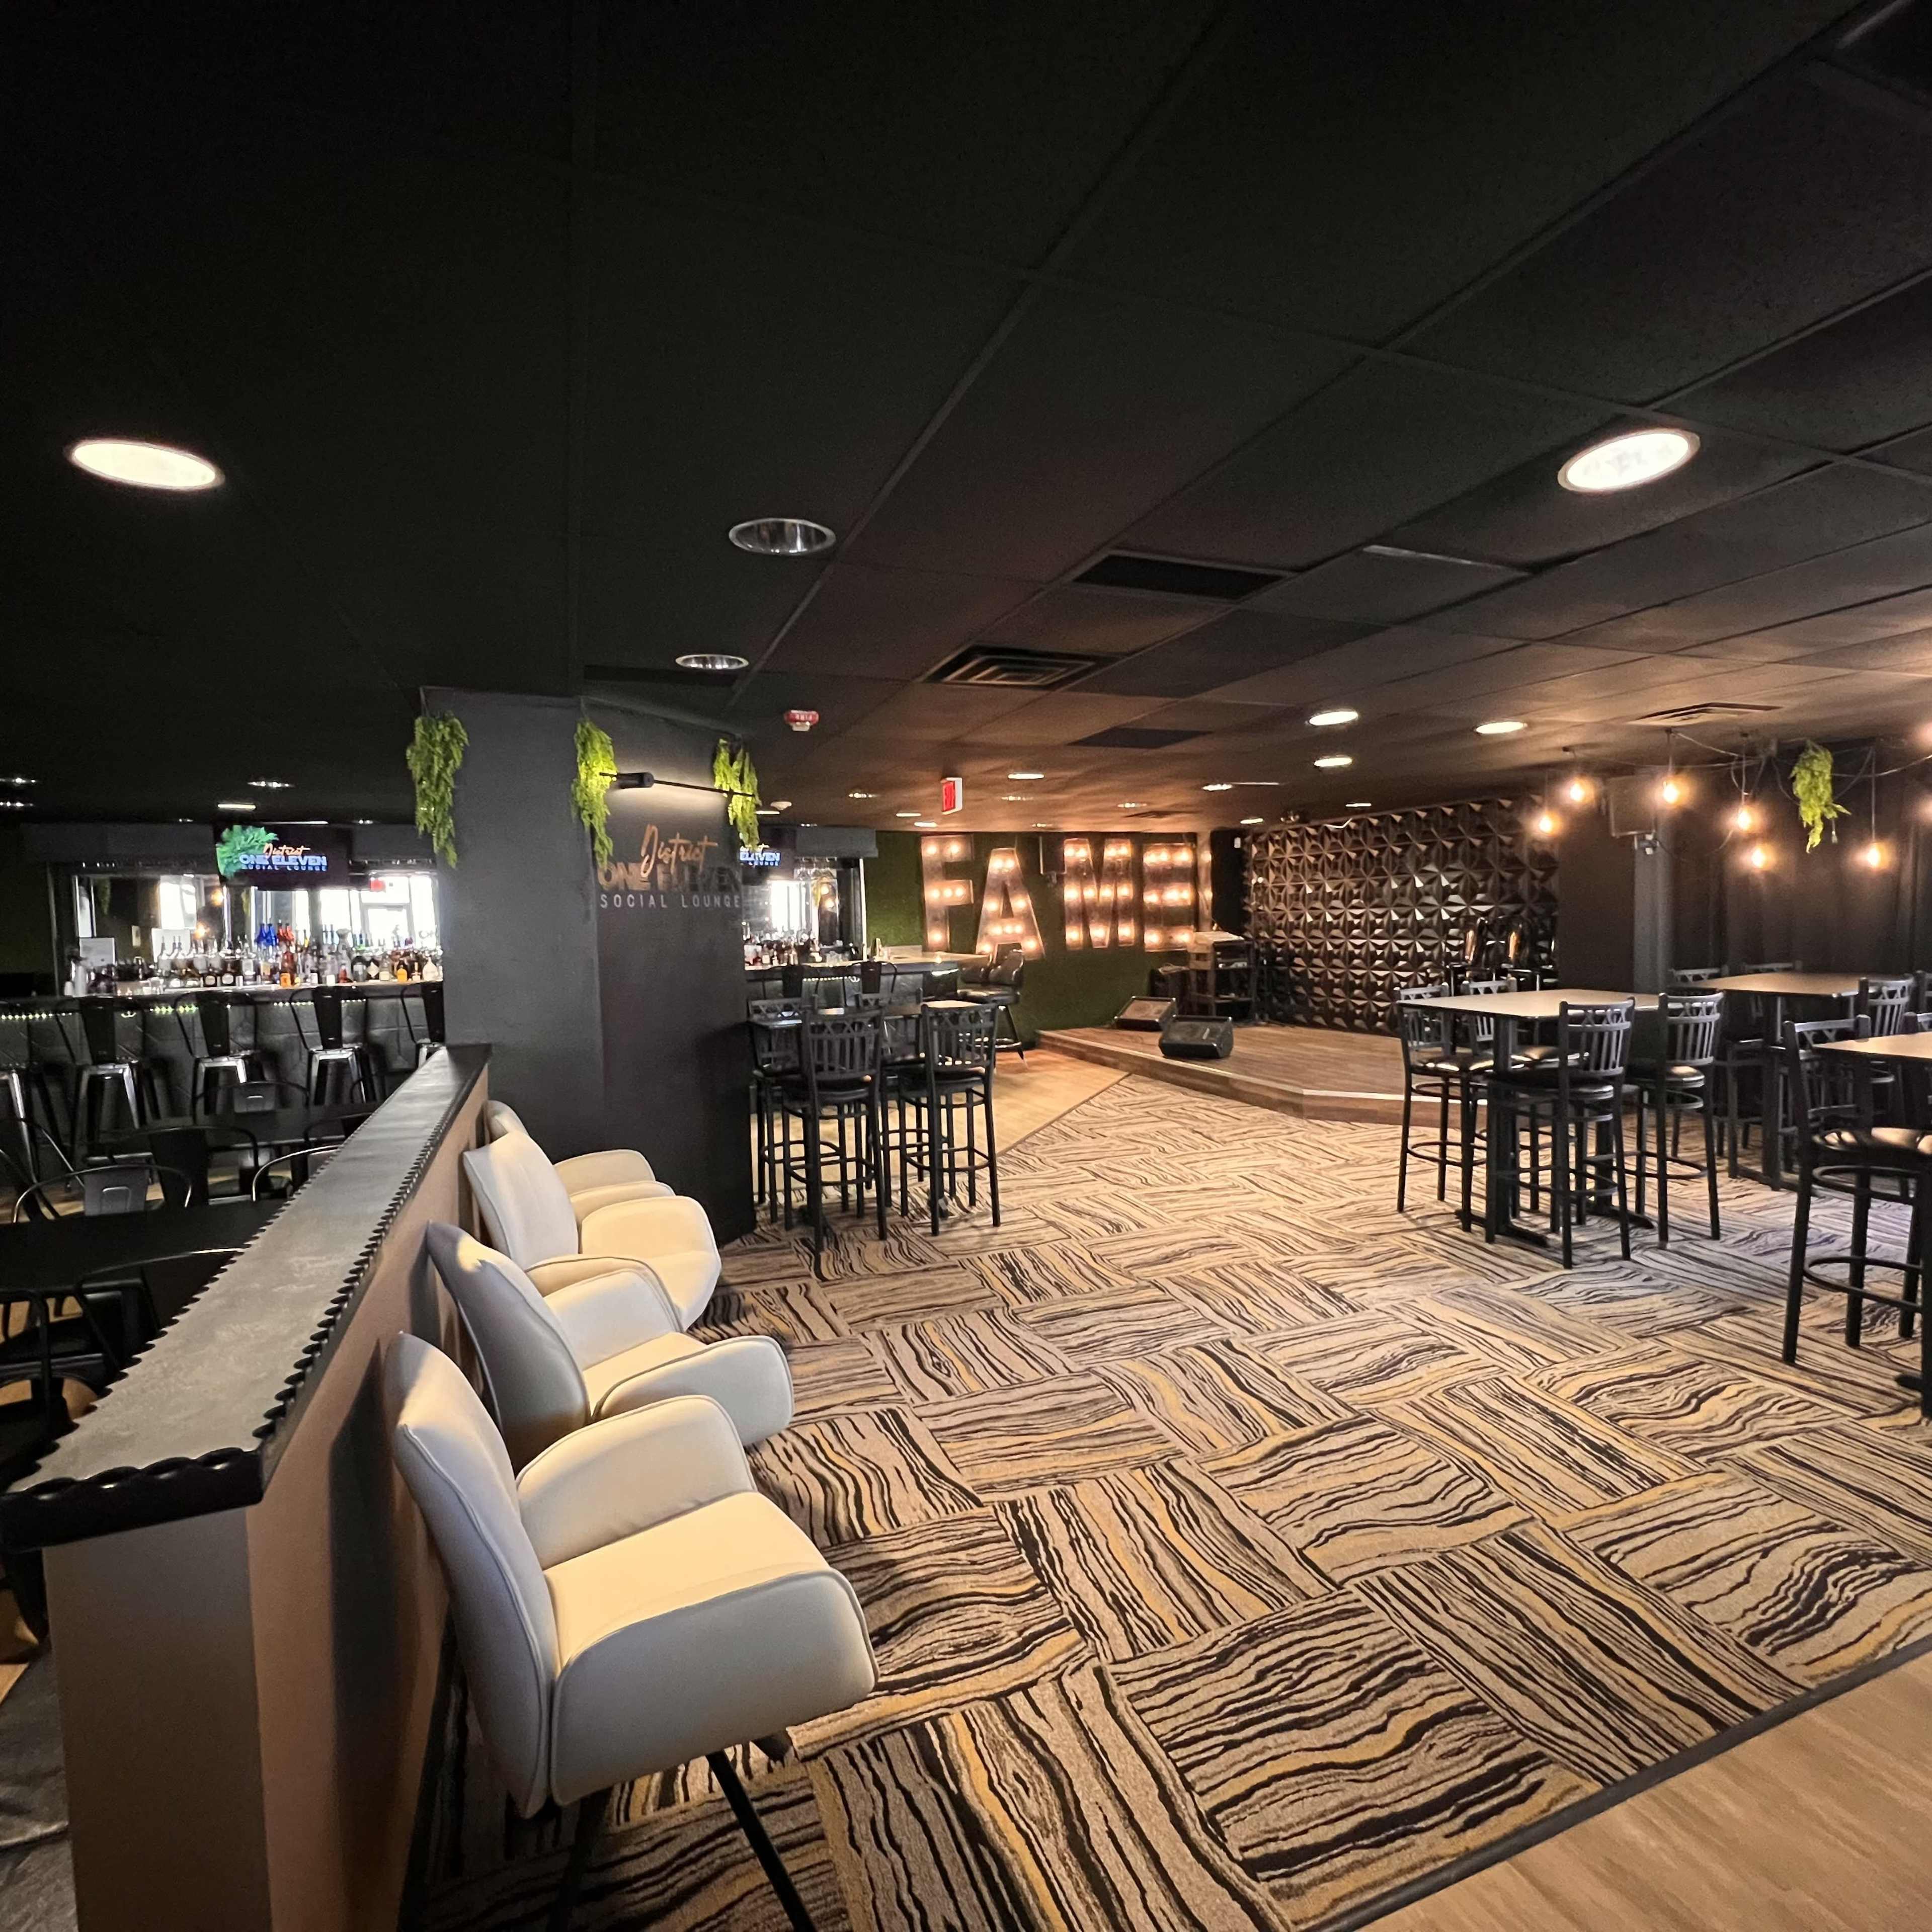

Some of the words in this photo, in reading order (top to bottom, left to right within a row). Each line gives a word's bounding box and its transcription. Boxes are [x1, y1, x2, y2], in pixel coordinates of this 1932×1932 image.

[239, 854, 269, 865] ONE
[272, 855, 327, 865] ELEVEN
[641, 824, 718, 876] District
[598, 861, 651, 890] ONE
[600, 894, 668, 908] SOCIAL
[681, 894, 741, 908] LOUNGE
[921, 835, 1195, 960] FAME
